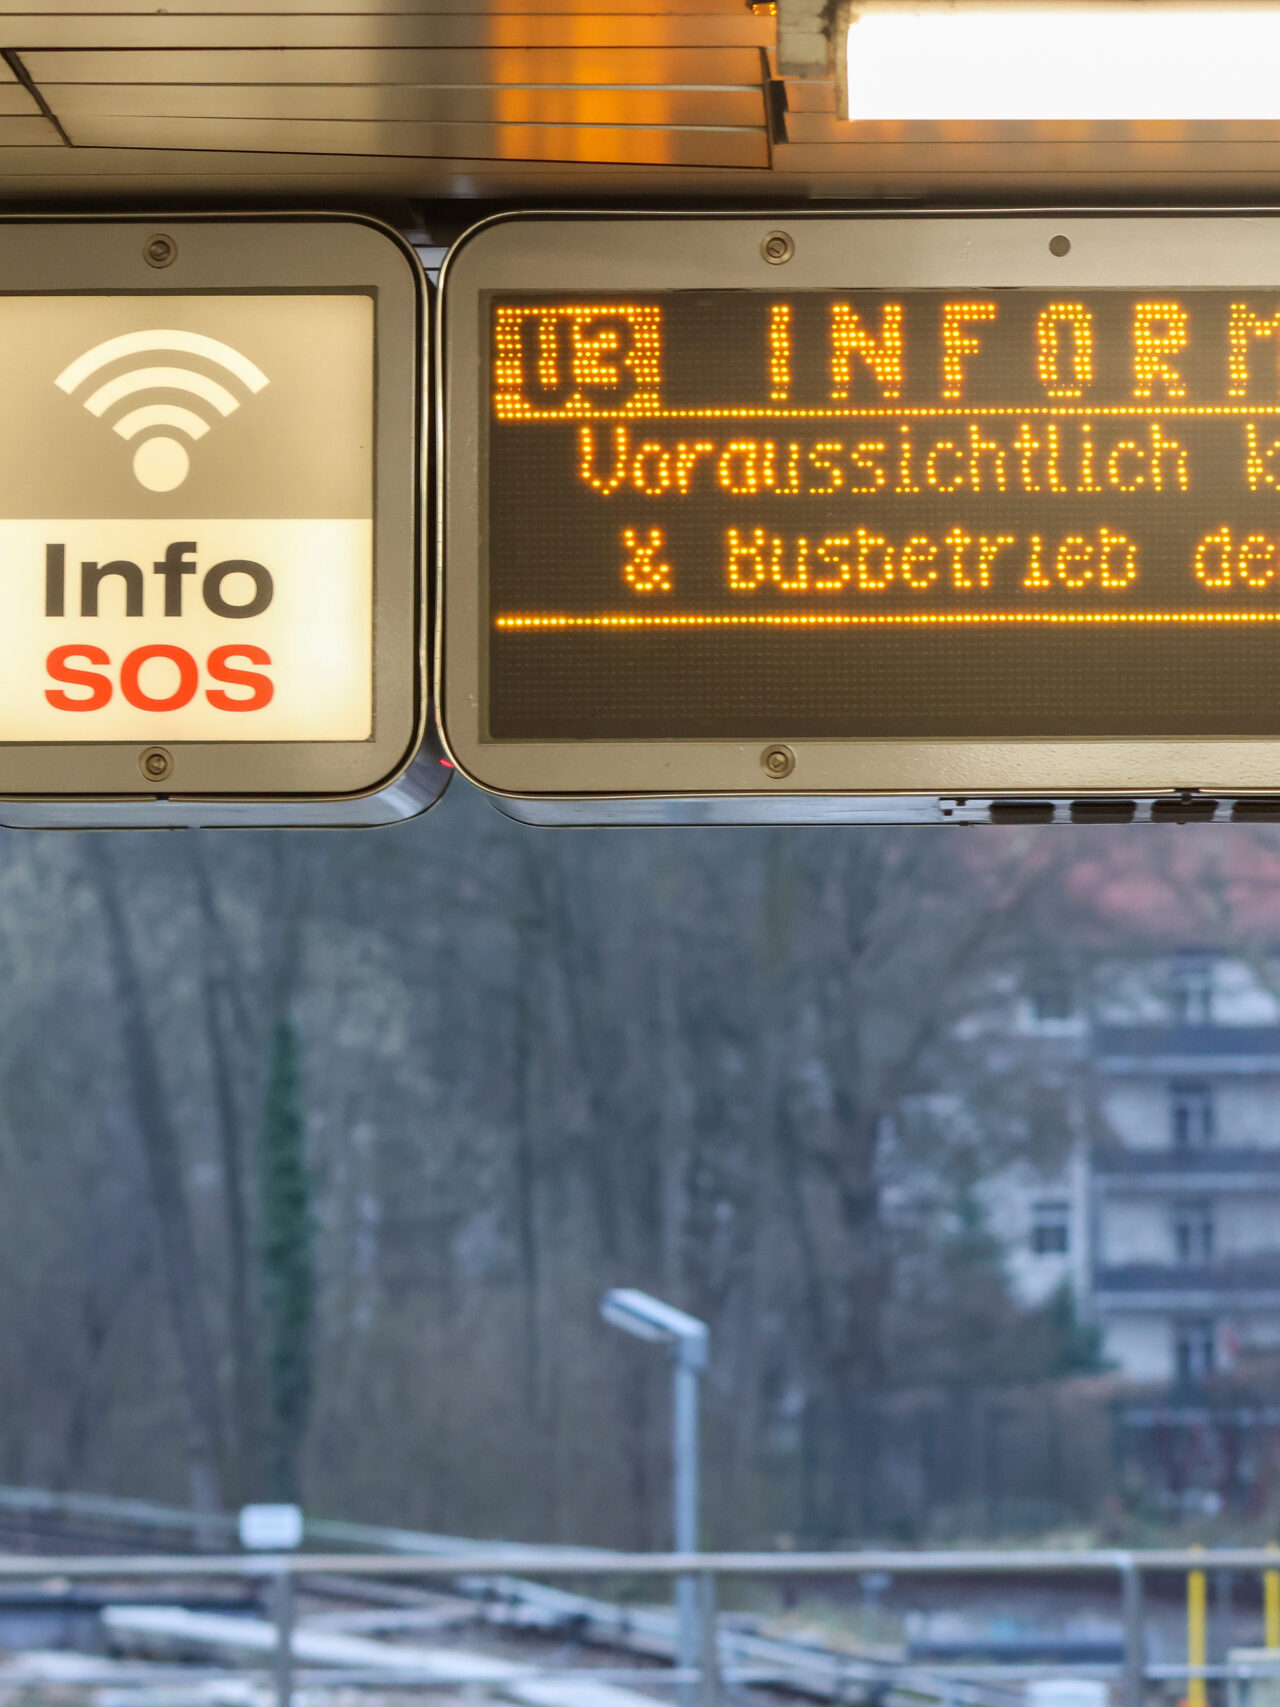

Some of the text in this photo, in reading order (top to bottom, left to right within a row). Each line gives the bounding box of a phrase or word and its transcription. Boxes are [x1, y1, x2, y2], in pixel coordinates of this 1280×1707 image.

[516, 312, 641, 413] U3
[581, 424, 1188, 494] Voraussichtlich
[45, 541, 274, 619] Info
[624, 528, 670, 591] &
[728, 527, 1136, 590] Busbetrieb
[45, 644, 274, 712] SOS
